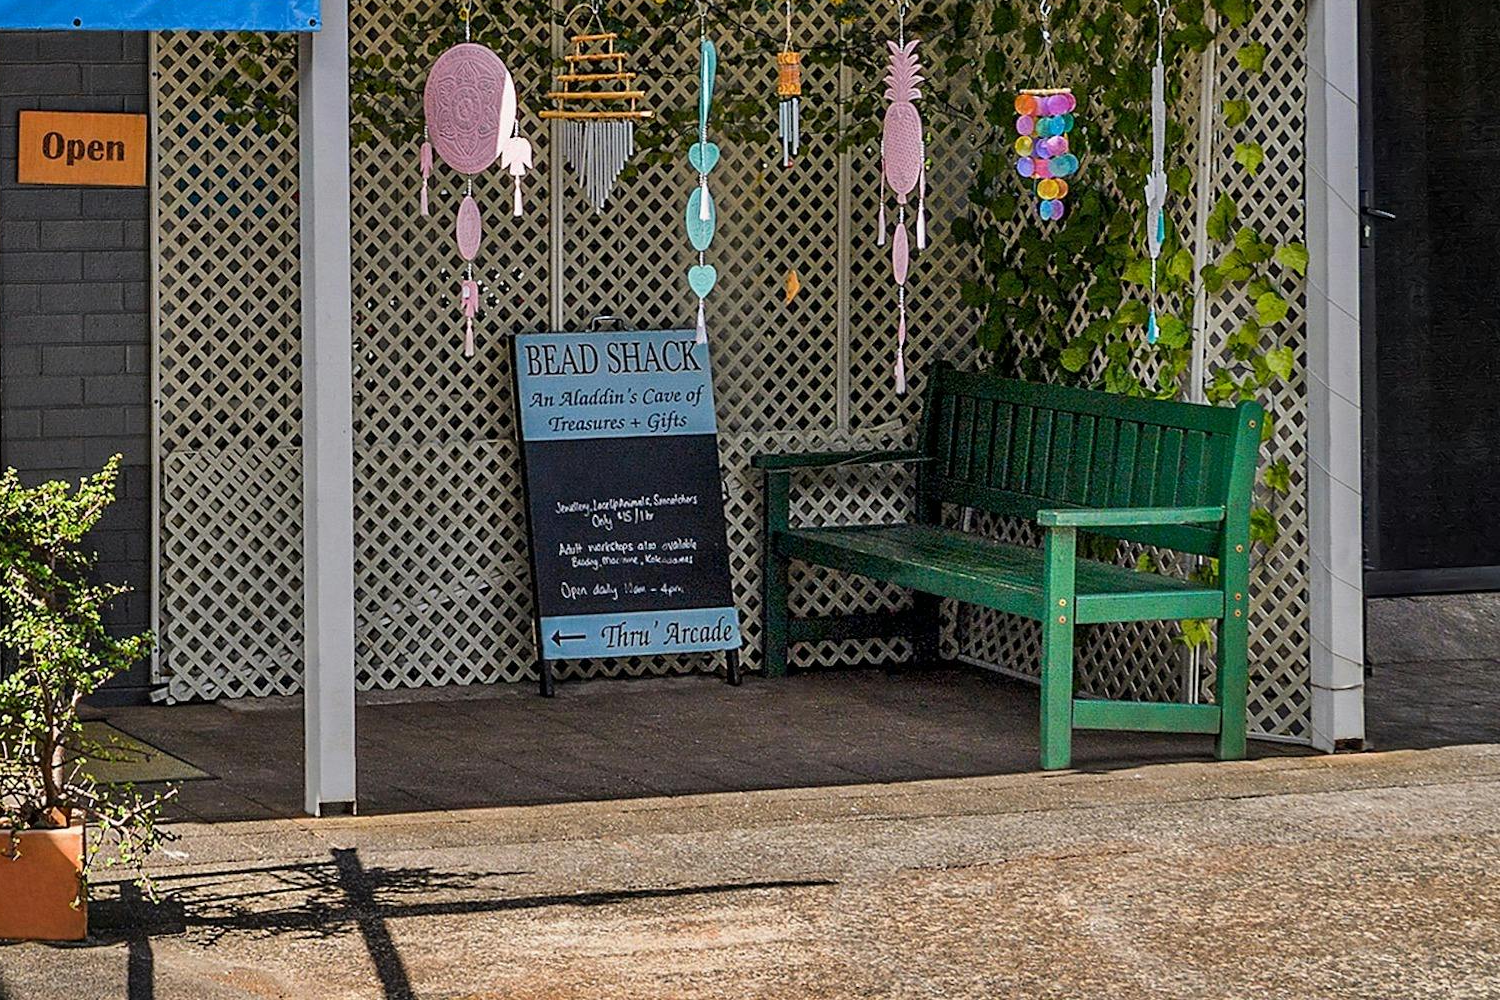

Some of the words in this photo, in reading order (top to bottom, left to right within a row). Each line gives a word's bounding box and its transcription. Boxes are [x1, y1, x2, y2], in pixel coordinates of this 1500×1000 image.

[42, 131, 125, 166] Open
[525, 343, 598, 376] BEAD
[607, 340, 701, 374] SHACK
[529, 391, 554, 408] An
[559, 388, 637, 407] Aladdin's
[642, 389, 681, 405] Cave
[686, 385, 705, 406] of
[548, 416, 625, 433] Treasures
[631, 418, 641, 428] +
[647, 411, 687, 433] Gifts
[591, 514, 613, 531] Only
[559, 543, 583, 556] Adult
[588, 541, 634, 554] workshops
[637, 541, 657, 551] also
[561, 582, 588, 600] Open
[593, 583, 619, 601] daily
[601, 621, 659, 648] Thru'
[663, 616, 733, 645] Arcade
